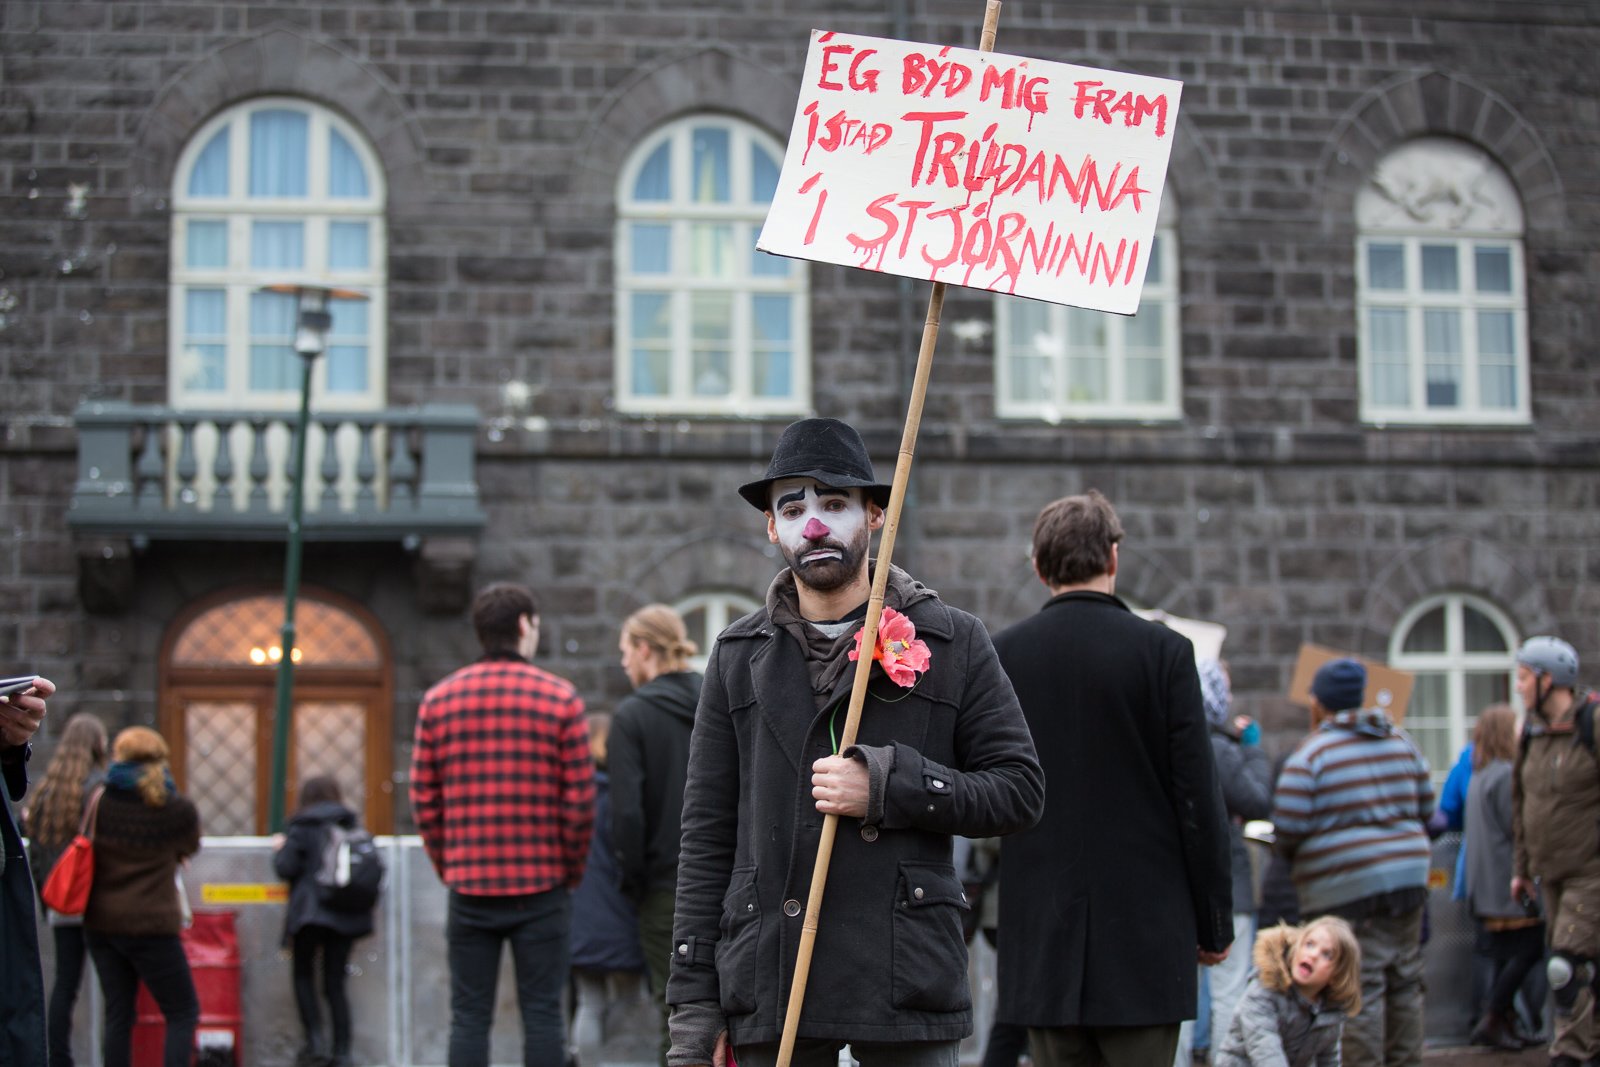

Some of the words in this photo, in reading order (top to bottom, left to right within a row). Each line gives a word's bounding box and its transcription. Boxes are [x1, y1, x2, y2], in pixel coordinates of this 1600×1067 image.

[818, 31, 880, 93] ÉG
[902, 46, 973, 98] BÝÐ
[1070, 81, 1168, 137] FRAM
